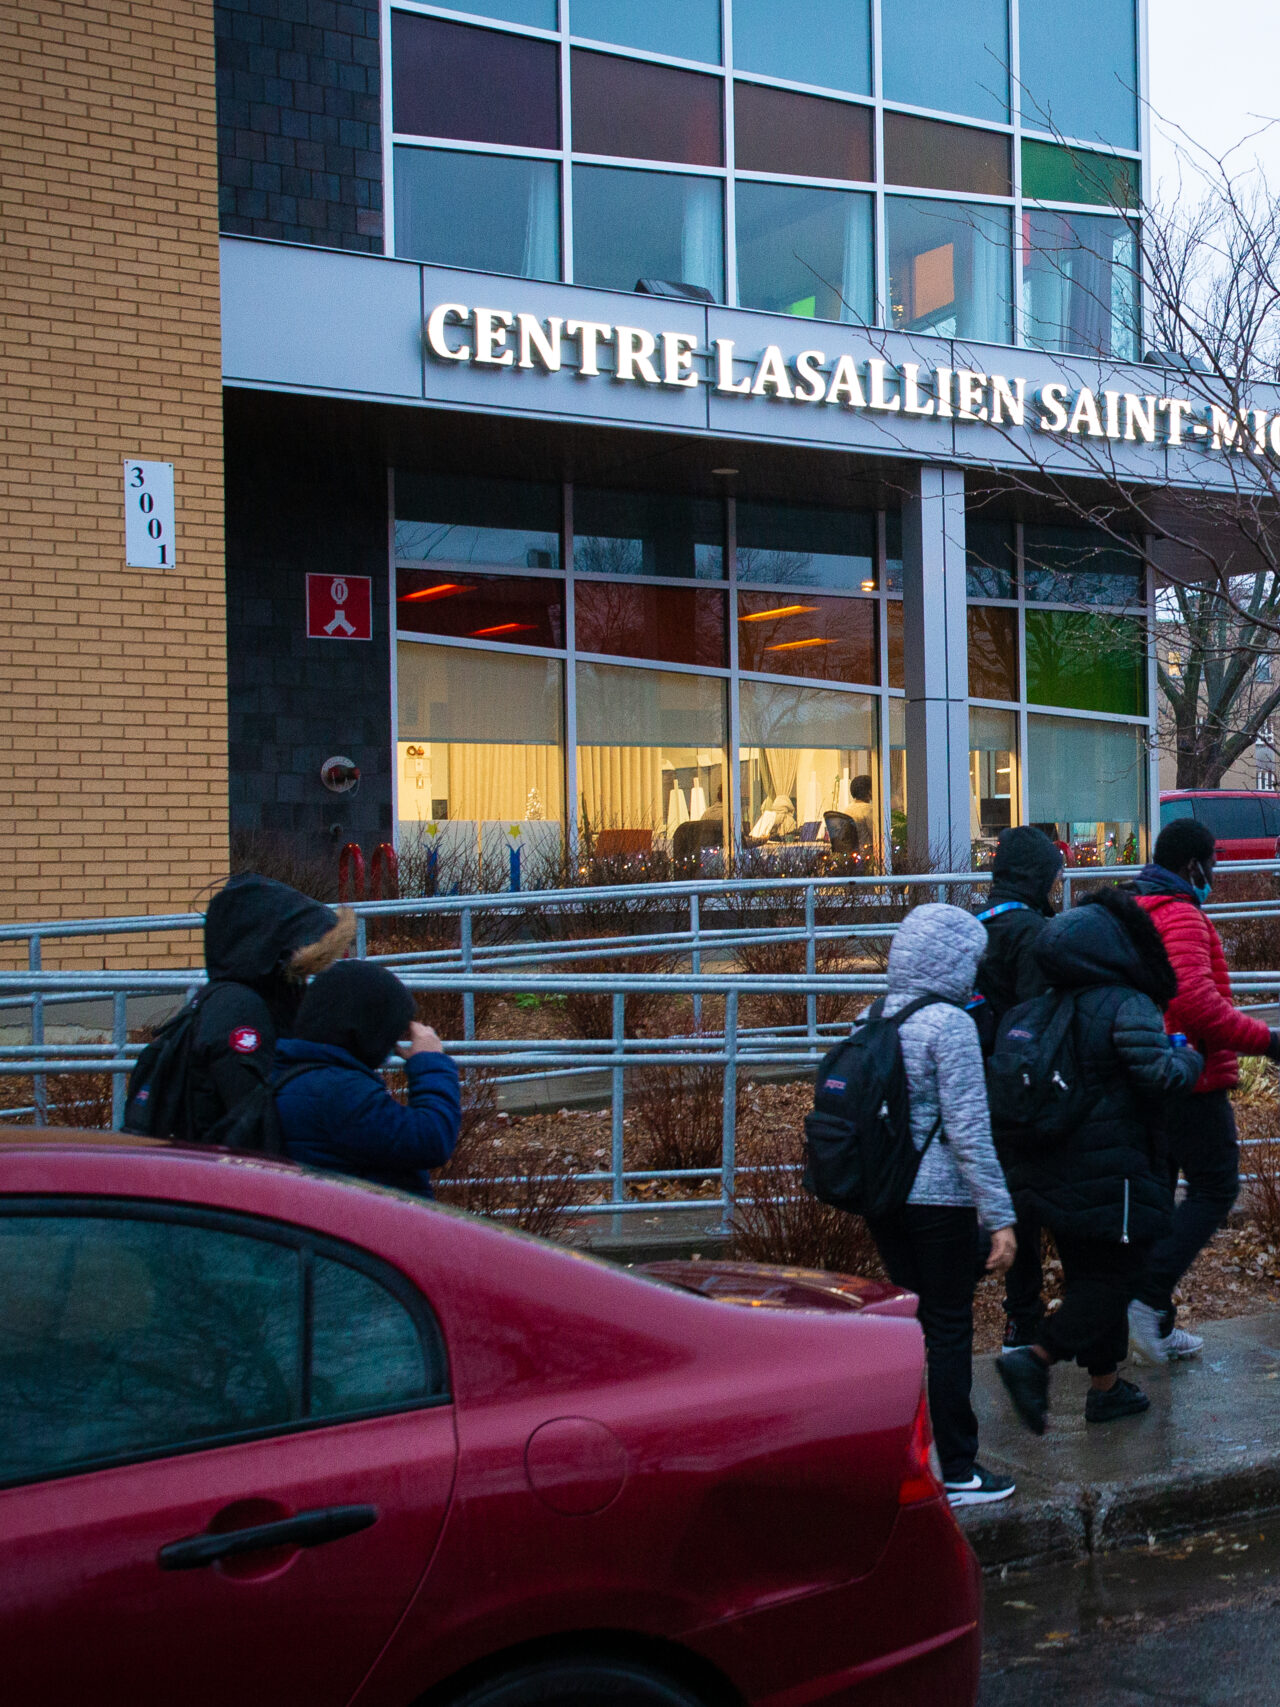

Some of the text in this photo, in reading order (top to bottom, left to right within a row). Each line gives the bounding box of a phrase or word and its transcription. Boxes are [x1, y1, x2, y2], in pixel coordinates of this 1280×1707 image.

[428, 303, 699, 388] CENTRE
[714, 339, 1026, 426] LASALLIEN
[130, 466, 169, 565] 3001
